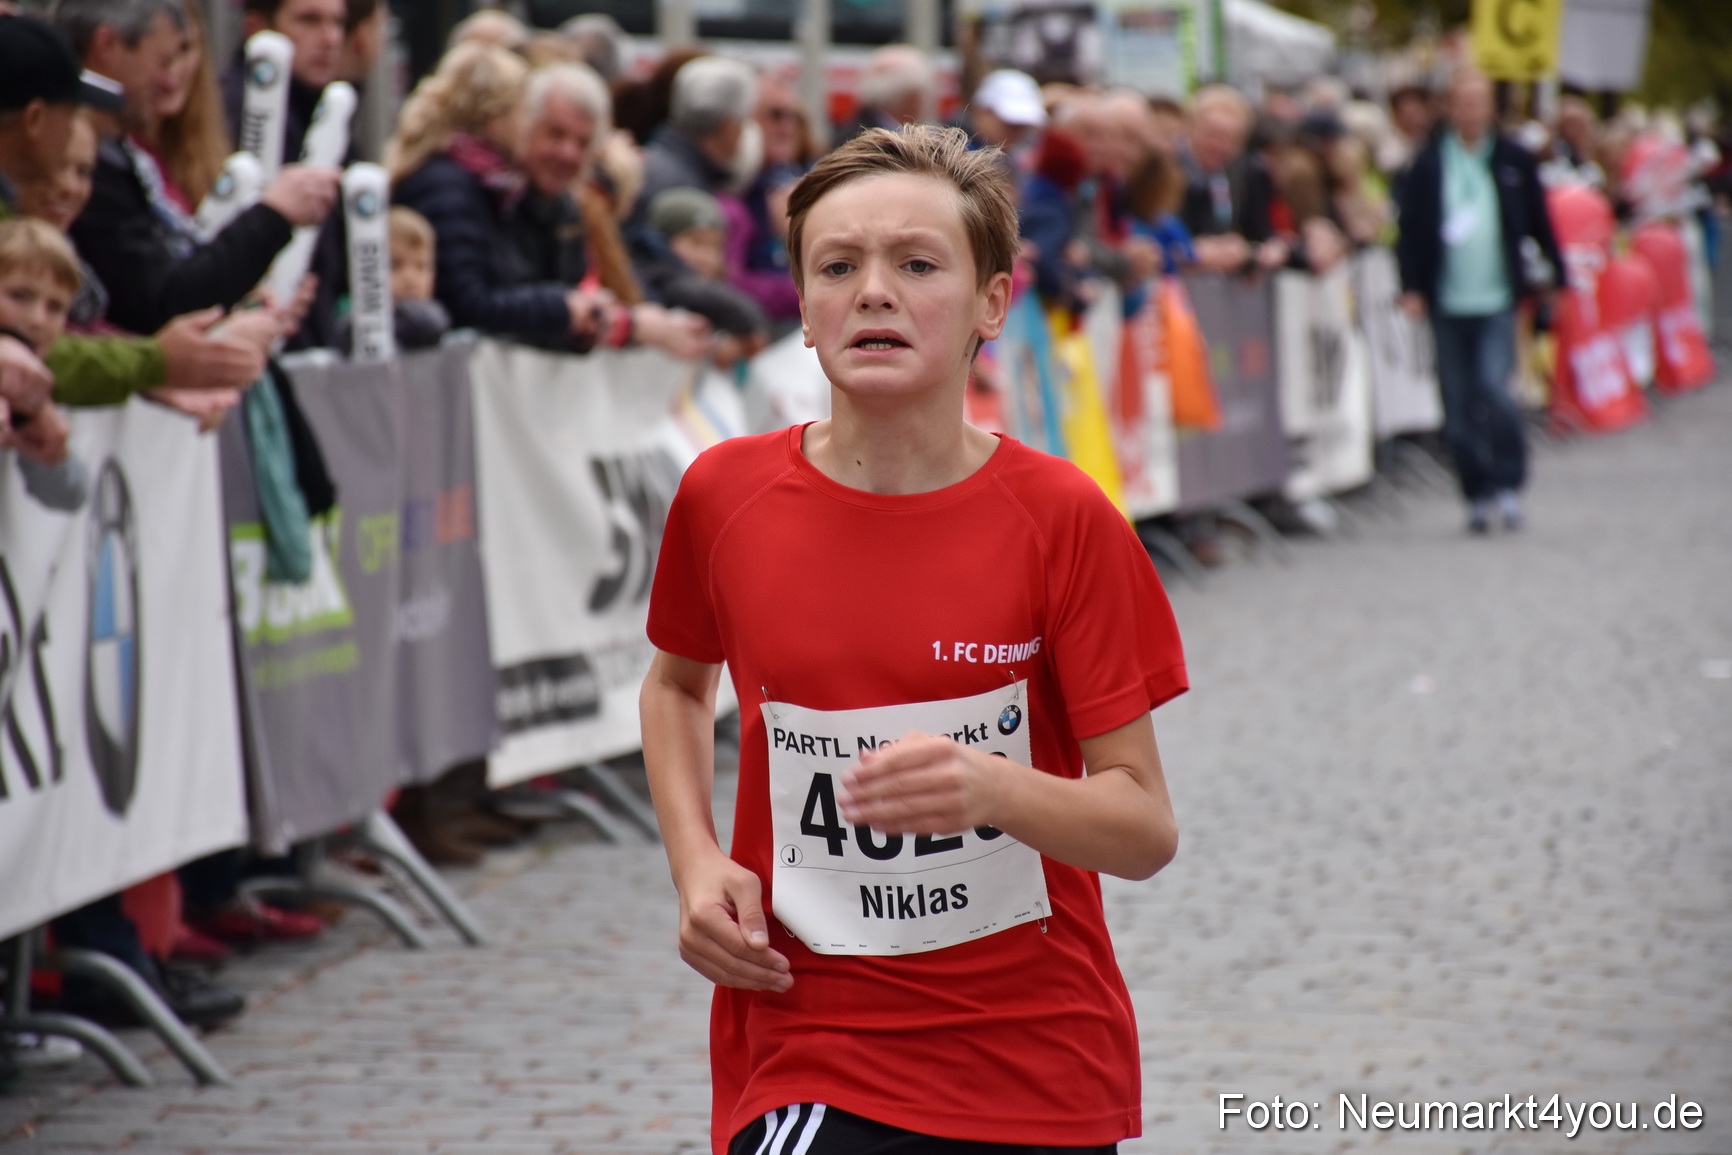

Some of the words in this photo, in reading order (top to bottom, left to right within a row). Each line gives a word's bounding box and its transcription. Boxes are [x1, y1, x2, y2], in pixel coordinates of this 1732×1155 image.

[932, 640, 948, 661] 1.
[954, 642, 978, 663] FC
[773, 727, 851, 758] PARTL
[787, 848, 796, 863] J
[860, 882, 968, 919] Niklas
